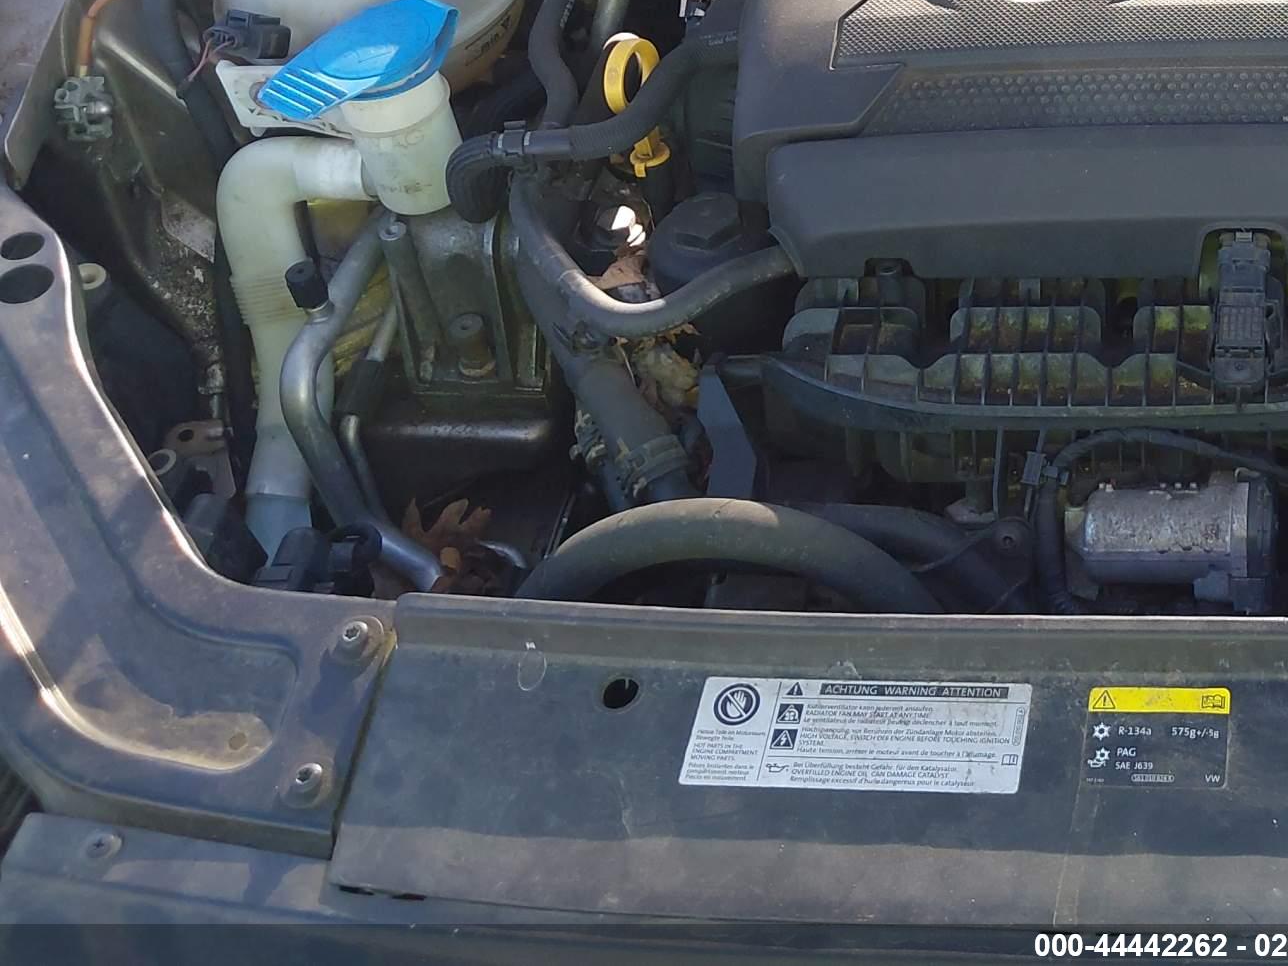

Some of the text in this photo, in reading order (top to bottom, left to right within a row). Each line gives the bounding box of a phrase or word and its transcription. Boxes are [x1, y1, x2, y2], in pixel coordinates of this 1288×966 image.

[825, 685, 1001, 698] ACHTUNG WARNING ATTENTION
[1118, 726, 1152, 735] R-134a
[1116, 747, 1137, 757] PAG
[1115, 762, 1153, 770] SAE J639
[1205, 775, 1220, 783] VW
